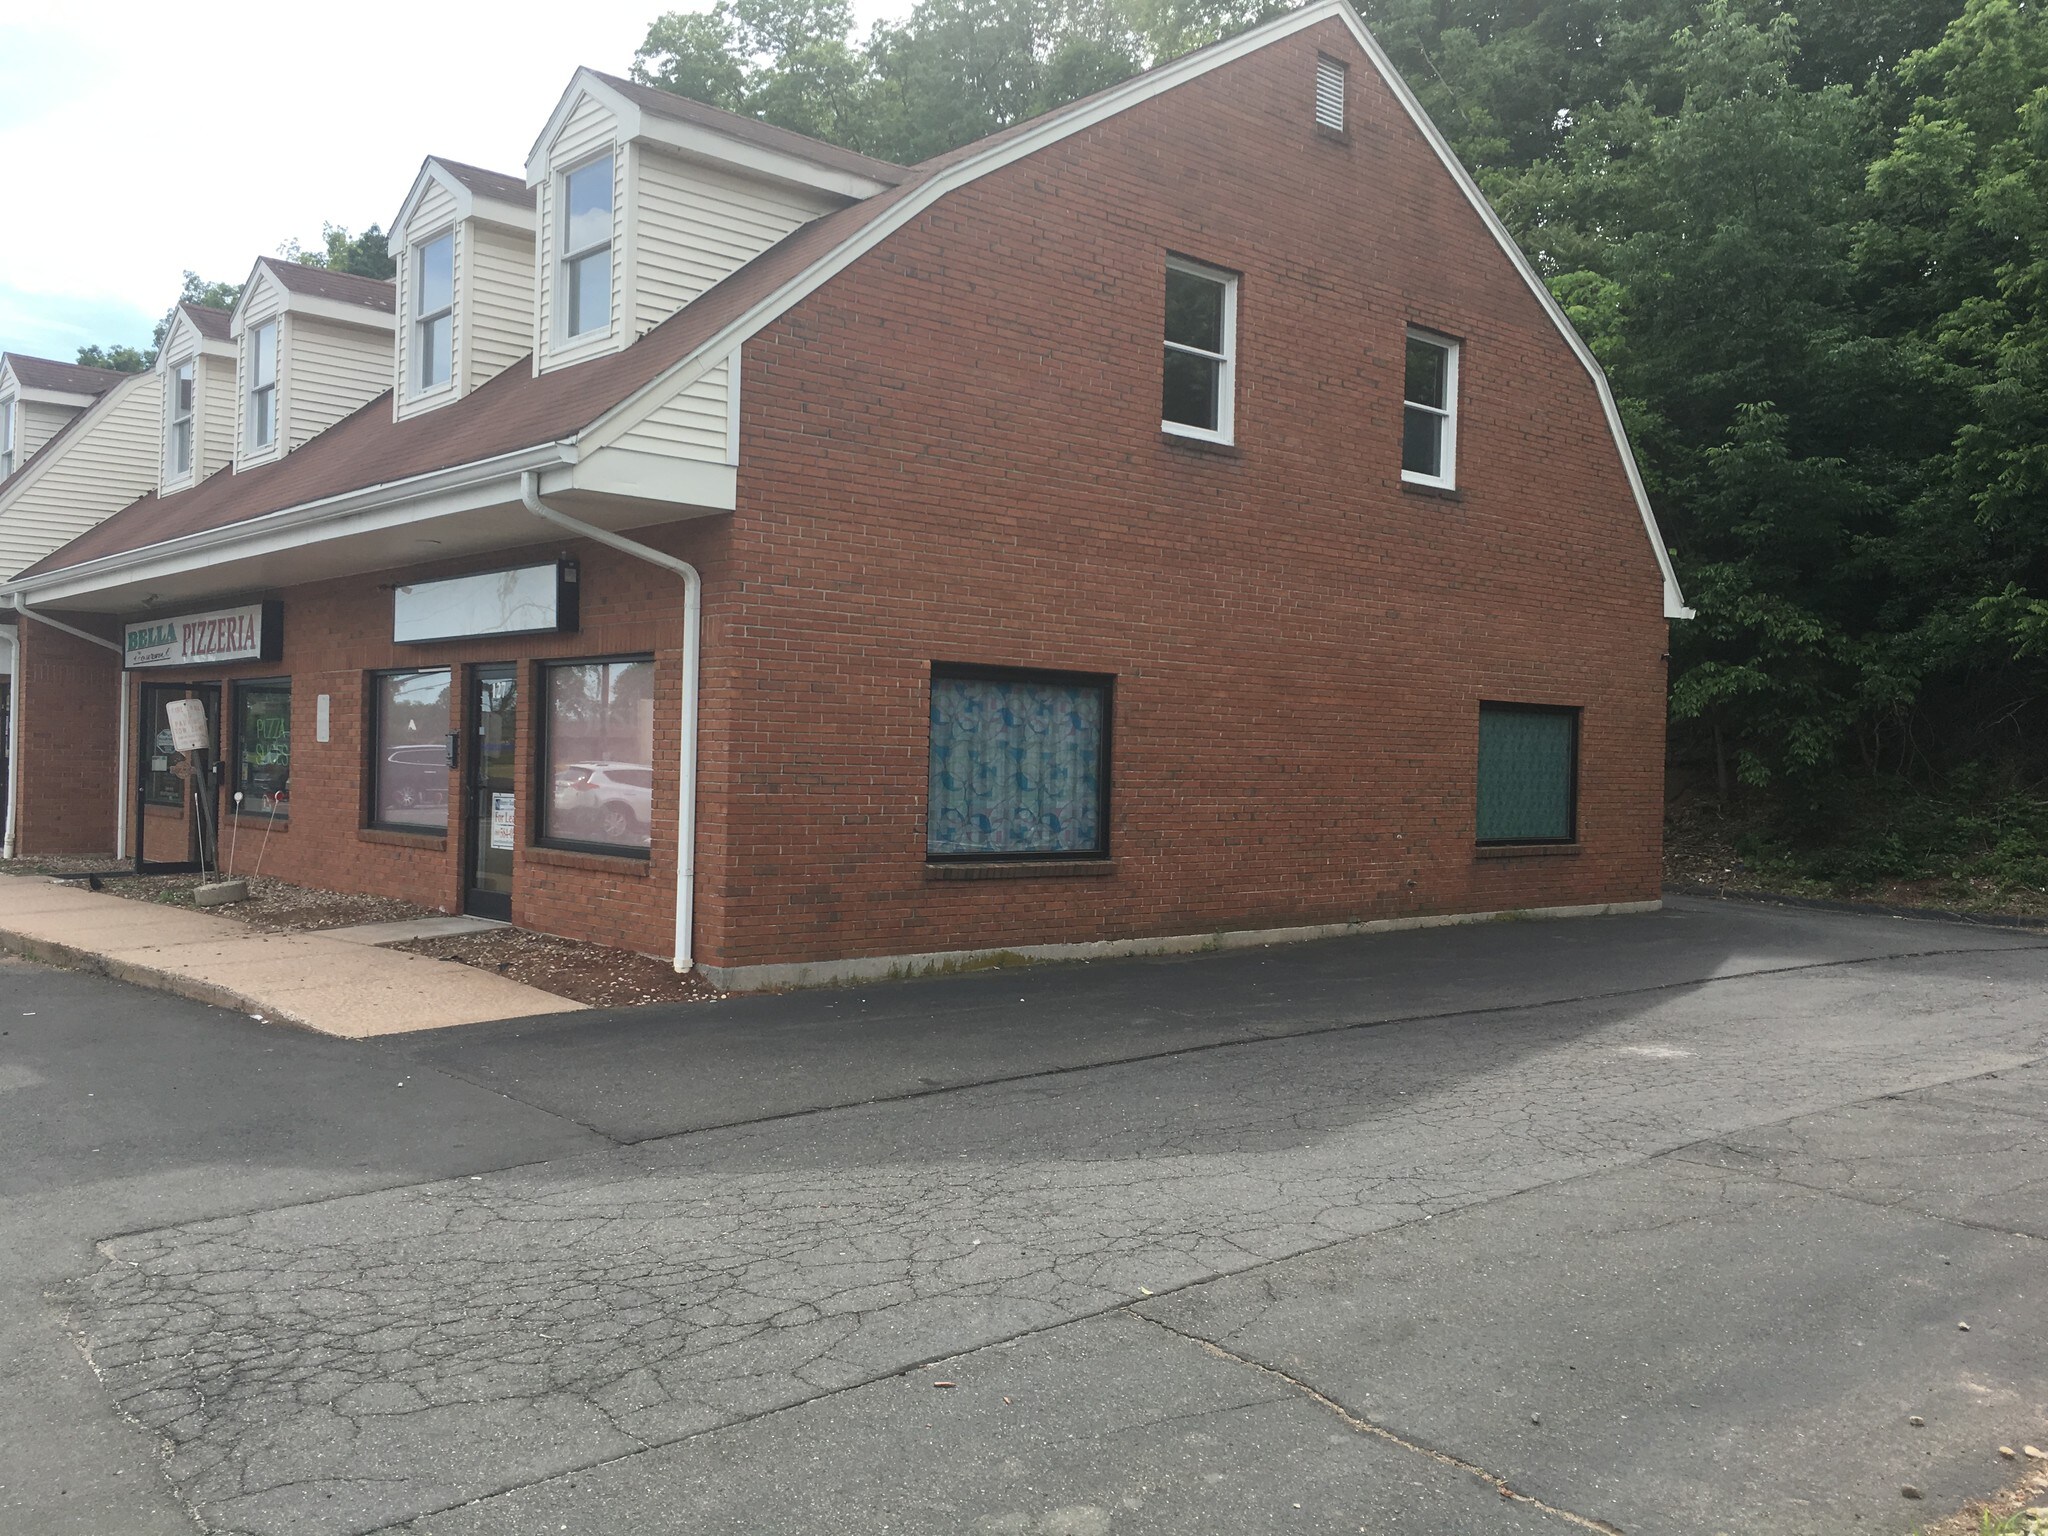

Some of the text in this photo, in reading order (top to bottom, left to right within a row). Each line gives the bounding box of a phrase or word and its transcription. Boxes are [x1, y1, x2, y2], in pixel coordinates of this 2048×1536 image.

[127, 614, 256, 657] BELLA PIZZERIA
[256, 718, 286, 738] PIZZA
[495, 811, 514, 824] For Lea
